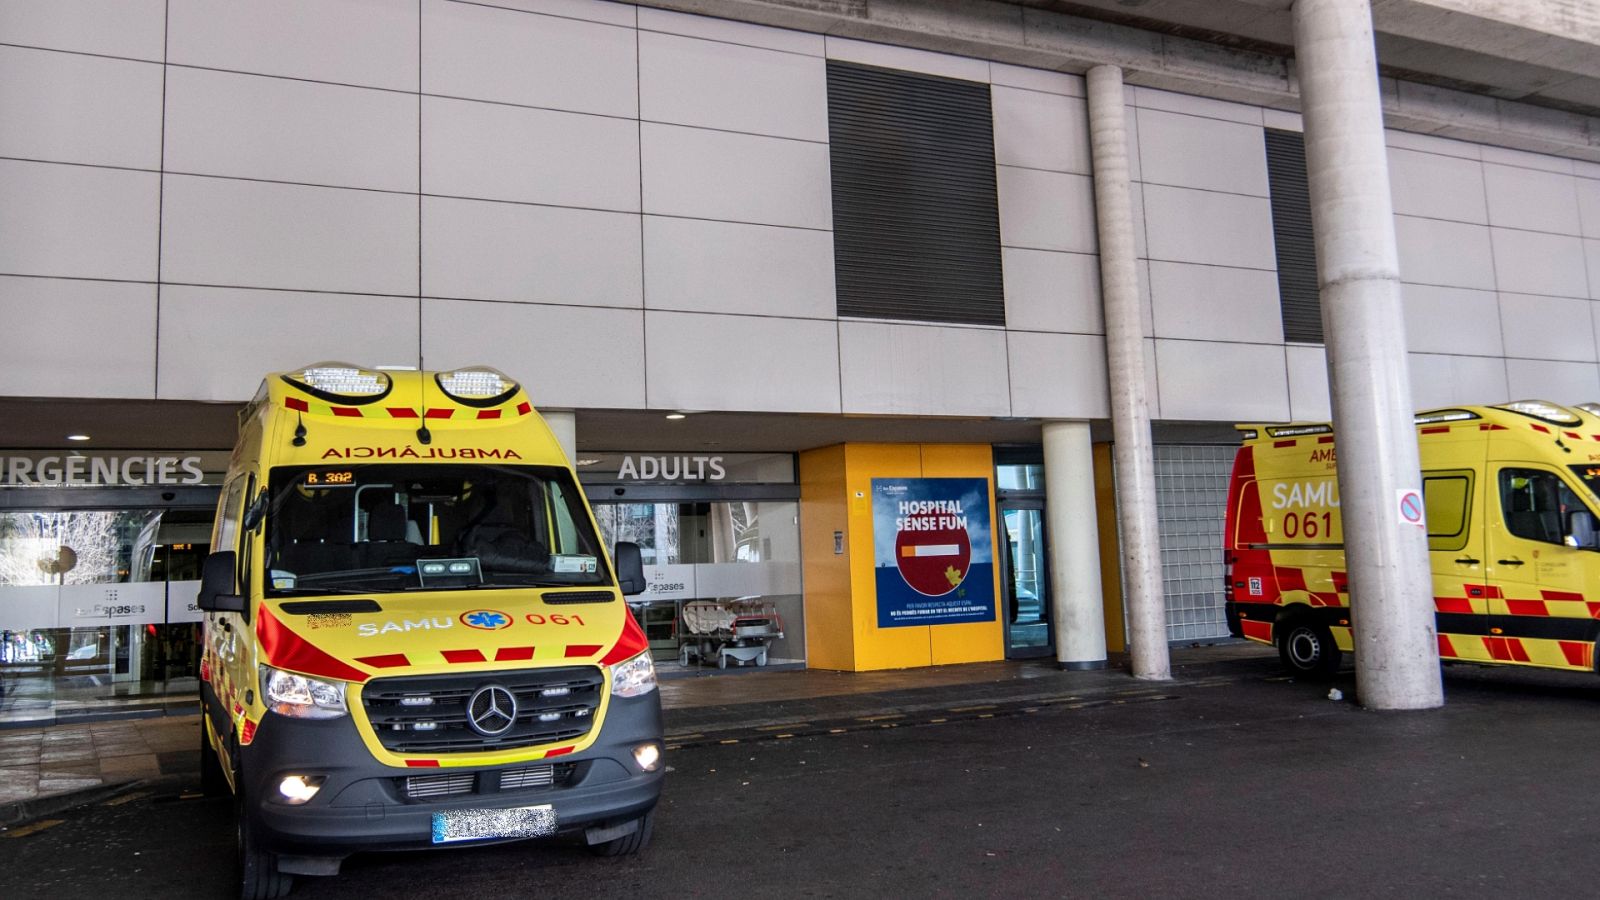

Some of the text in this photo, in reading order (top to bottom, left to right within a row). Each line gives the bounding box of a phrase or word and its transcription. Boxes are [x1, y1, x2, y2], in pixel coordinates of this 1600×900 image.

[1309, 449, 1337, 462] AMB
[0, 451, 204, 484] RGÈNCIES
[617, 456, 726, 480] ADULTS
[308, 472, 318, 483] B
[1271, 481, 1341, 509] SAMU
[898, 500, 964, 515] HOSPITAL
[895, 516, 968, 531] SENSE FUM
[1283, 511, 1331, 539] 061
[647, 582, 685, 595] Espases
[1250, 581, 1261, 589] 112
[187, 603, 200, 612] So
[357, 617, 454, 637] SAMU
[525, 613, 585, 626] 061
